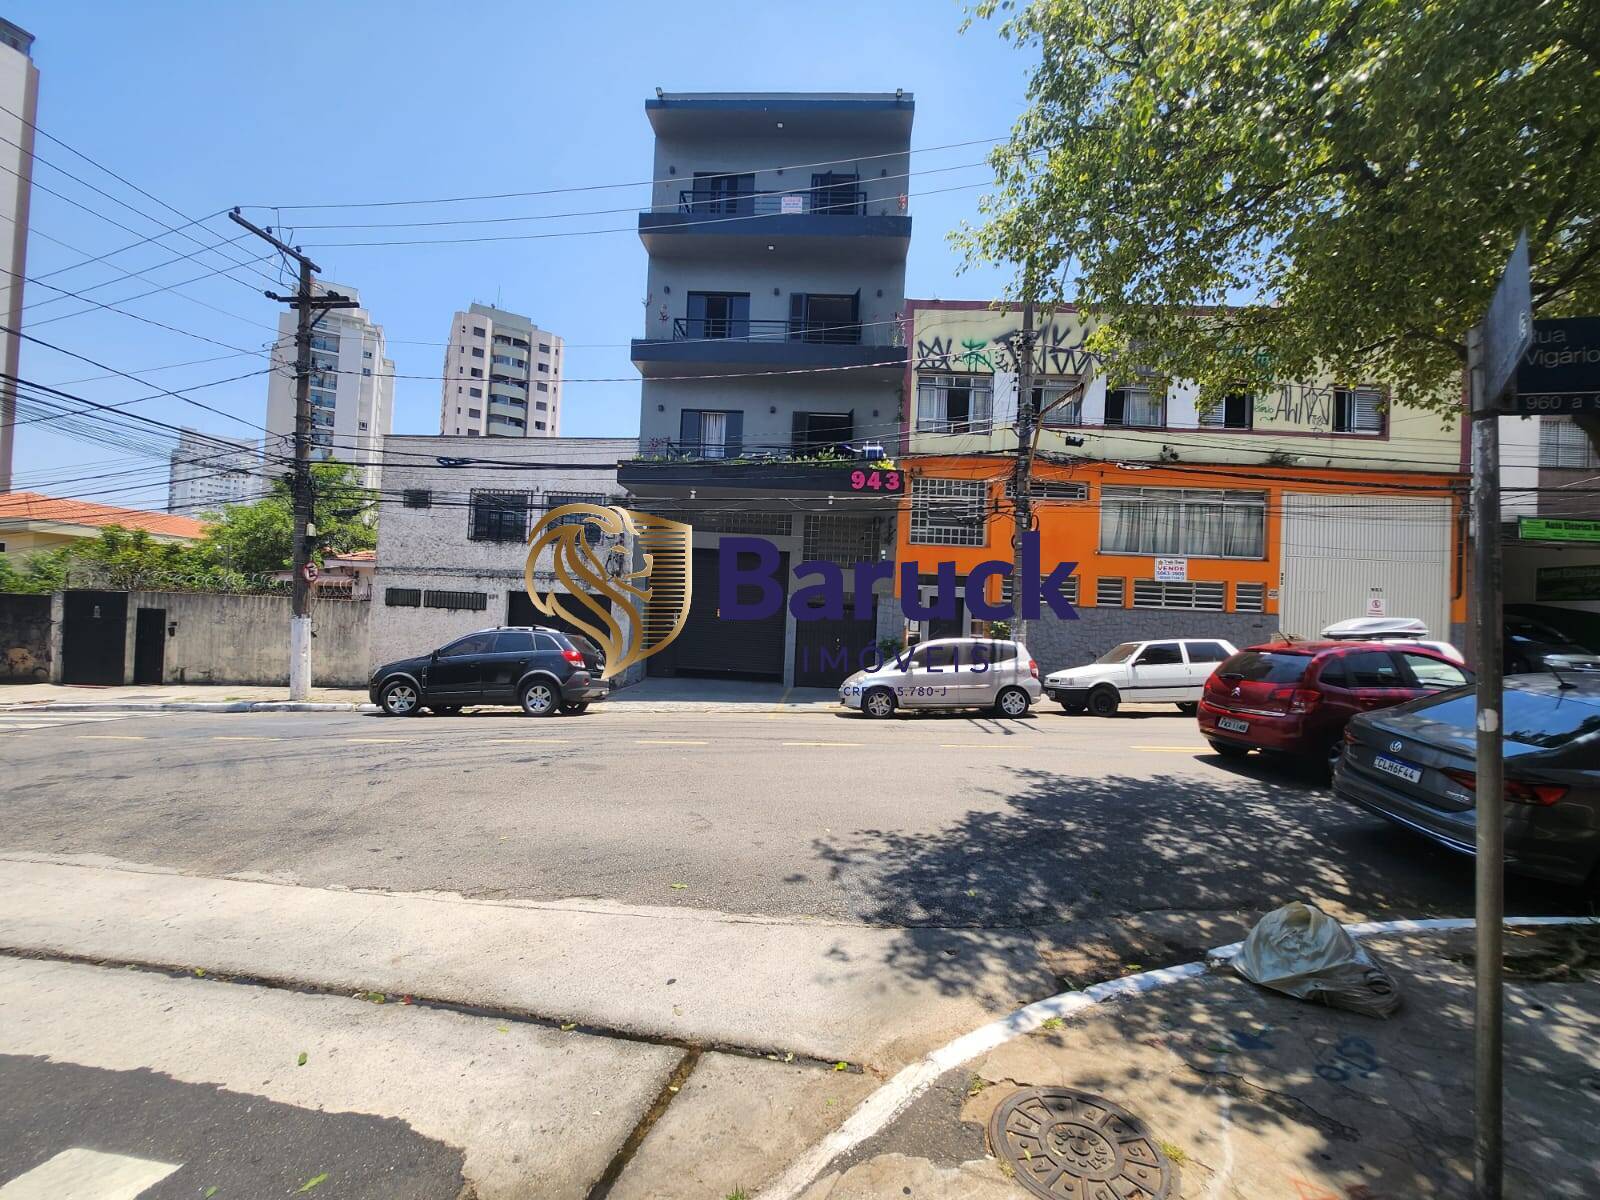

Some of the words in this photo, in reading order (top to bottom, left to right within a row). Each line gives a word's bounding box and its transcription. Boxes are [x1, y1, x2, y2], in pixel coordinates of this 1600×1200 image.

[1525, 346, 1600, 368] Vigário
[1526, 396, 1561, 409] 960
[1572, 397, 1582, 408] a
[851, 470, 900, 490] 943
